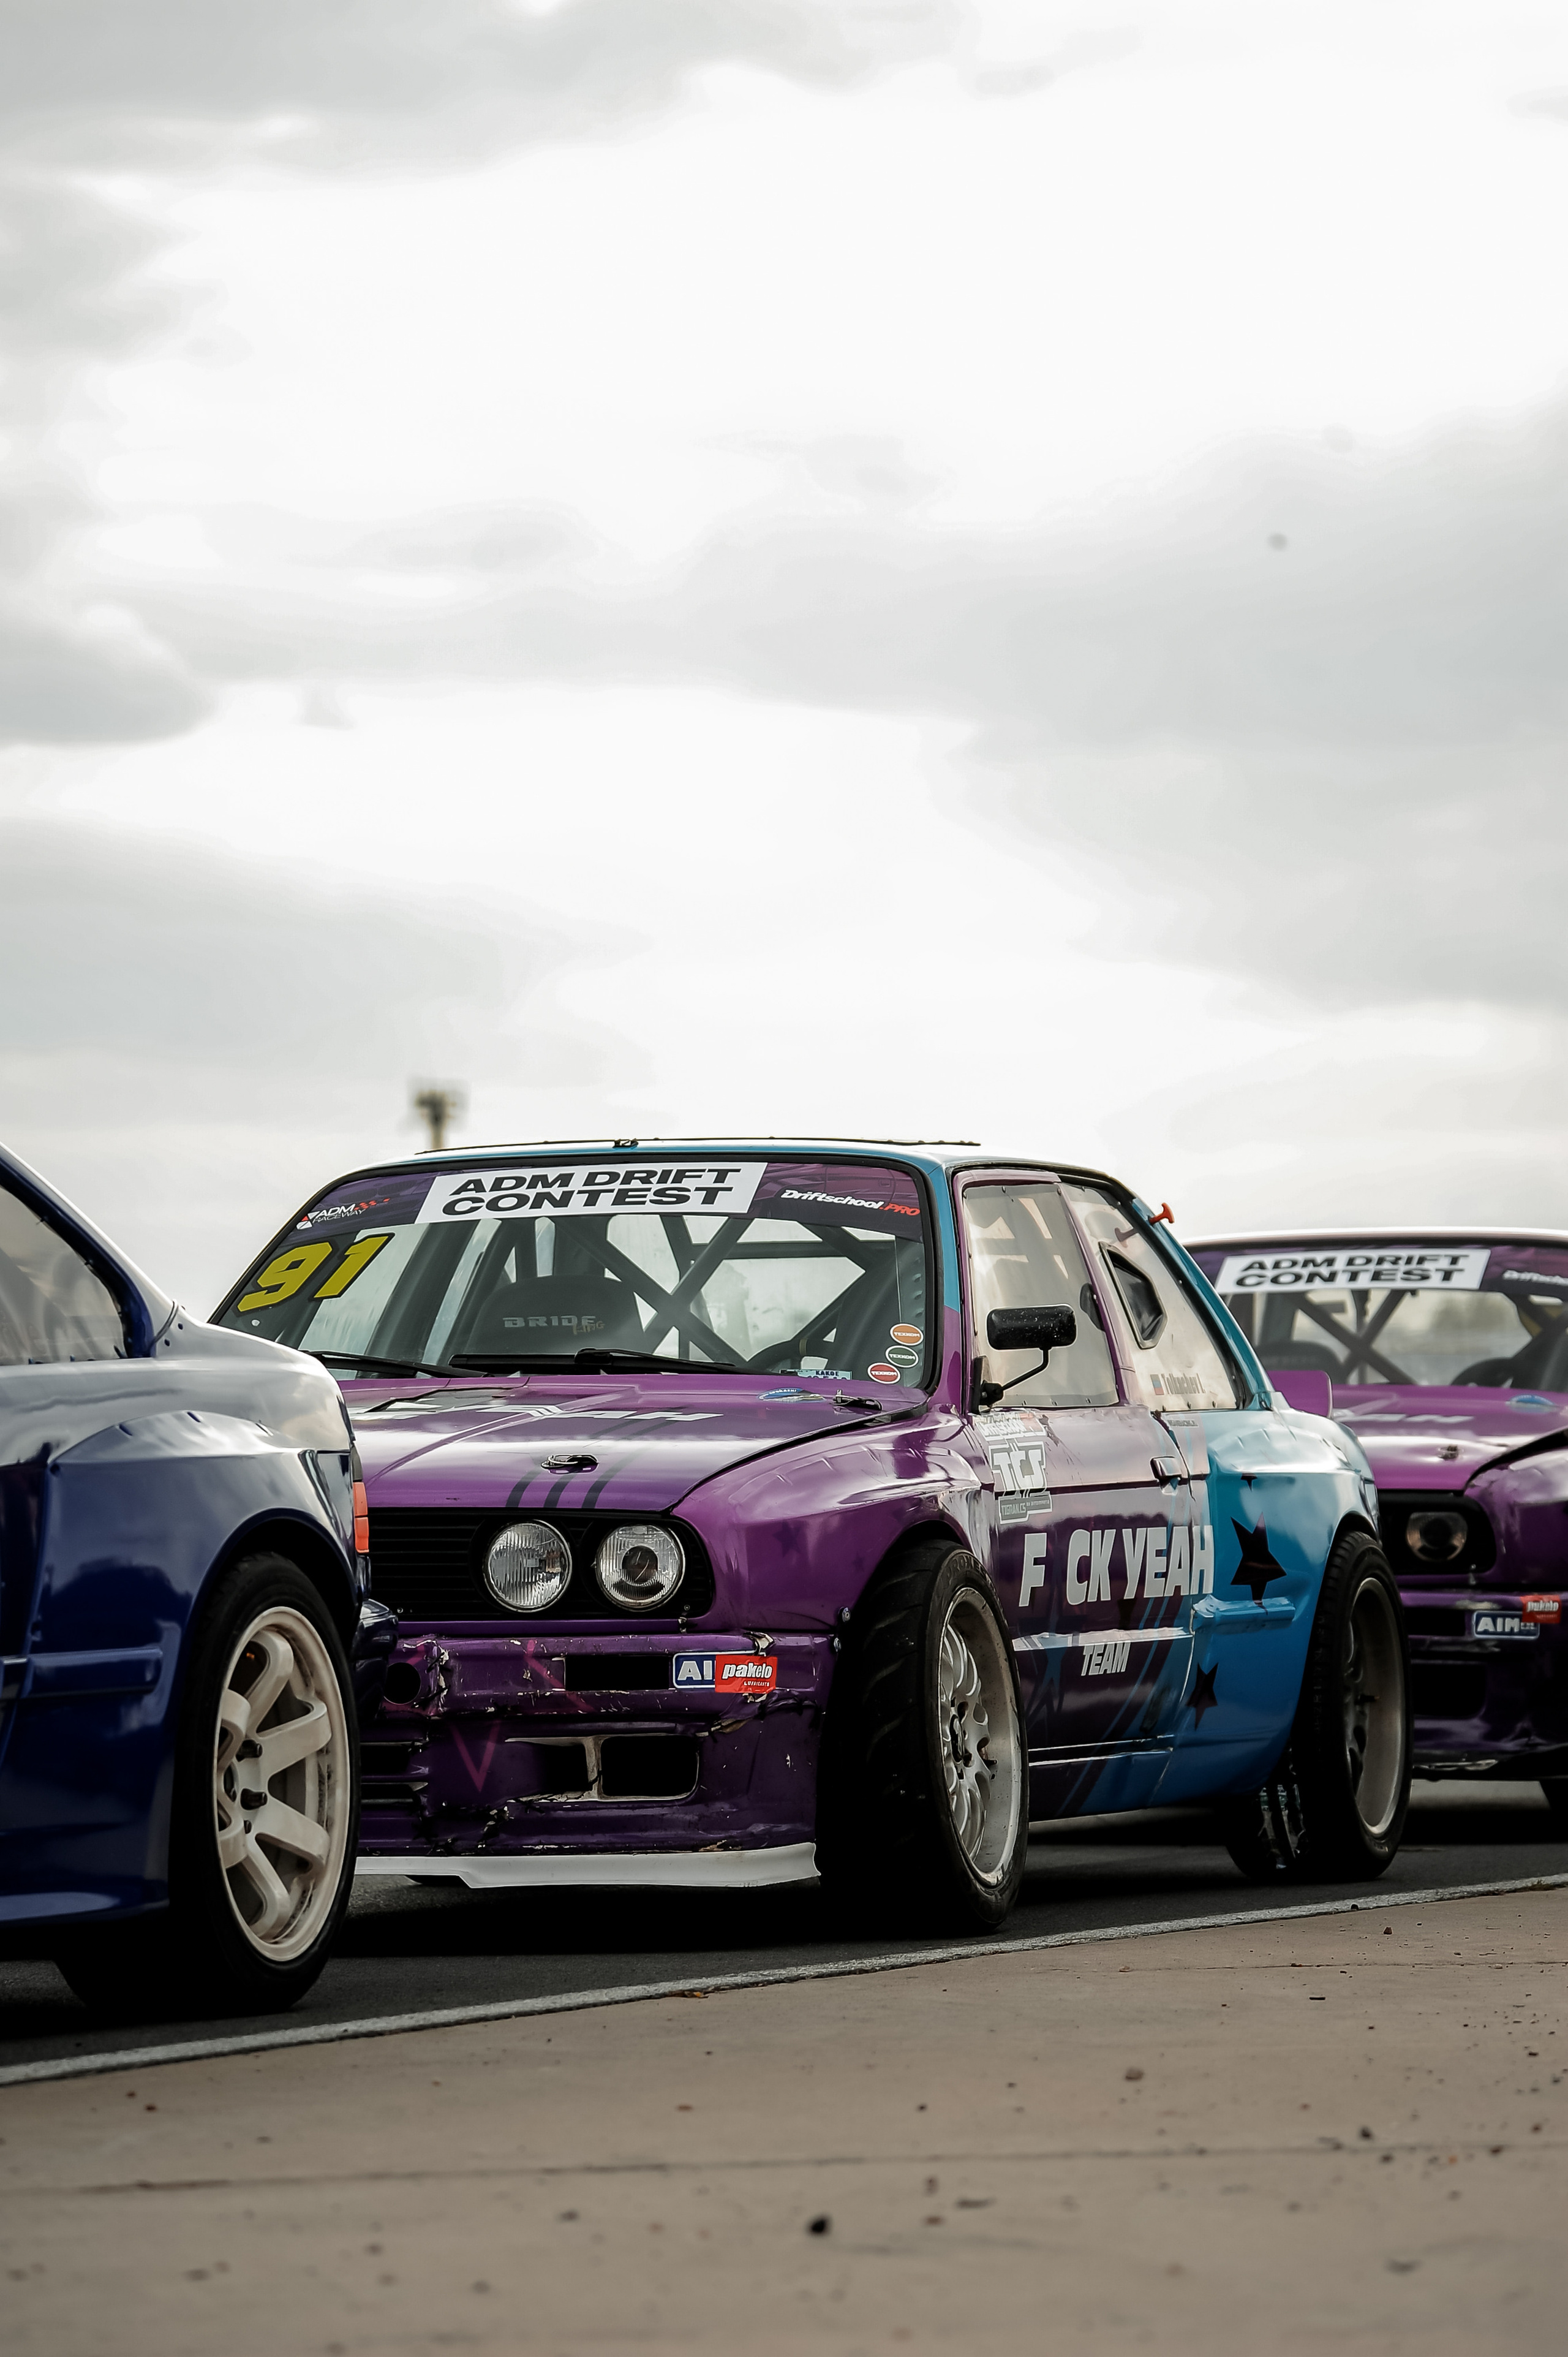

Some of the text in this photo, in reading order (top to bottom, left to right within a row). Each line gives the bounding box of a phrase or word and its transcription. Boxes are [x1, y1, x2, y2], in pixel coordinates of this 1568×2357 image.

[449, 1168, 742, 1196] ADM DRIFT
[316, 1203, 356, 1217] ADM
[442, 1186, 734, 1216] CONTEST
[312, 1209, 366, 1224] RACEWAY
[1242, 1254, 1470, 1271] ADM DRIFT
[236, 1234, 392, 1314] 91
[1235, 1268, 1464, 1286] CONTEST
[502, 1315, 596, 1328] BRIDE
[1122, 1525, 1215, 1599] YEAH
[1477, 1616, 1520, 1632] AIM
[1081, 1641, 1131, 1676] TEAM
[677, 1660, 715, 1681] AI
[722, 1663, 772, 1679] pakelo
